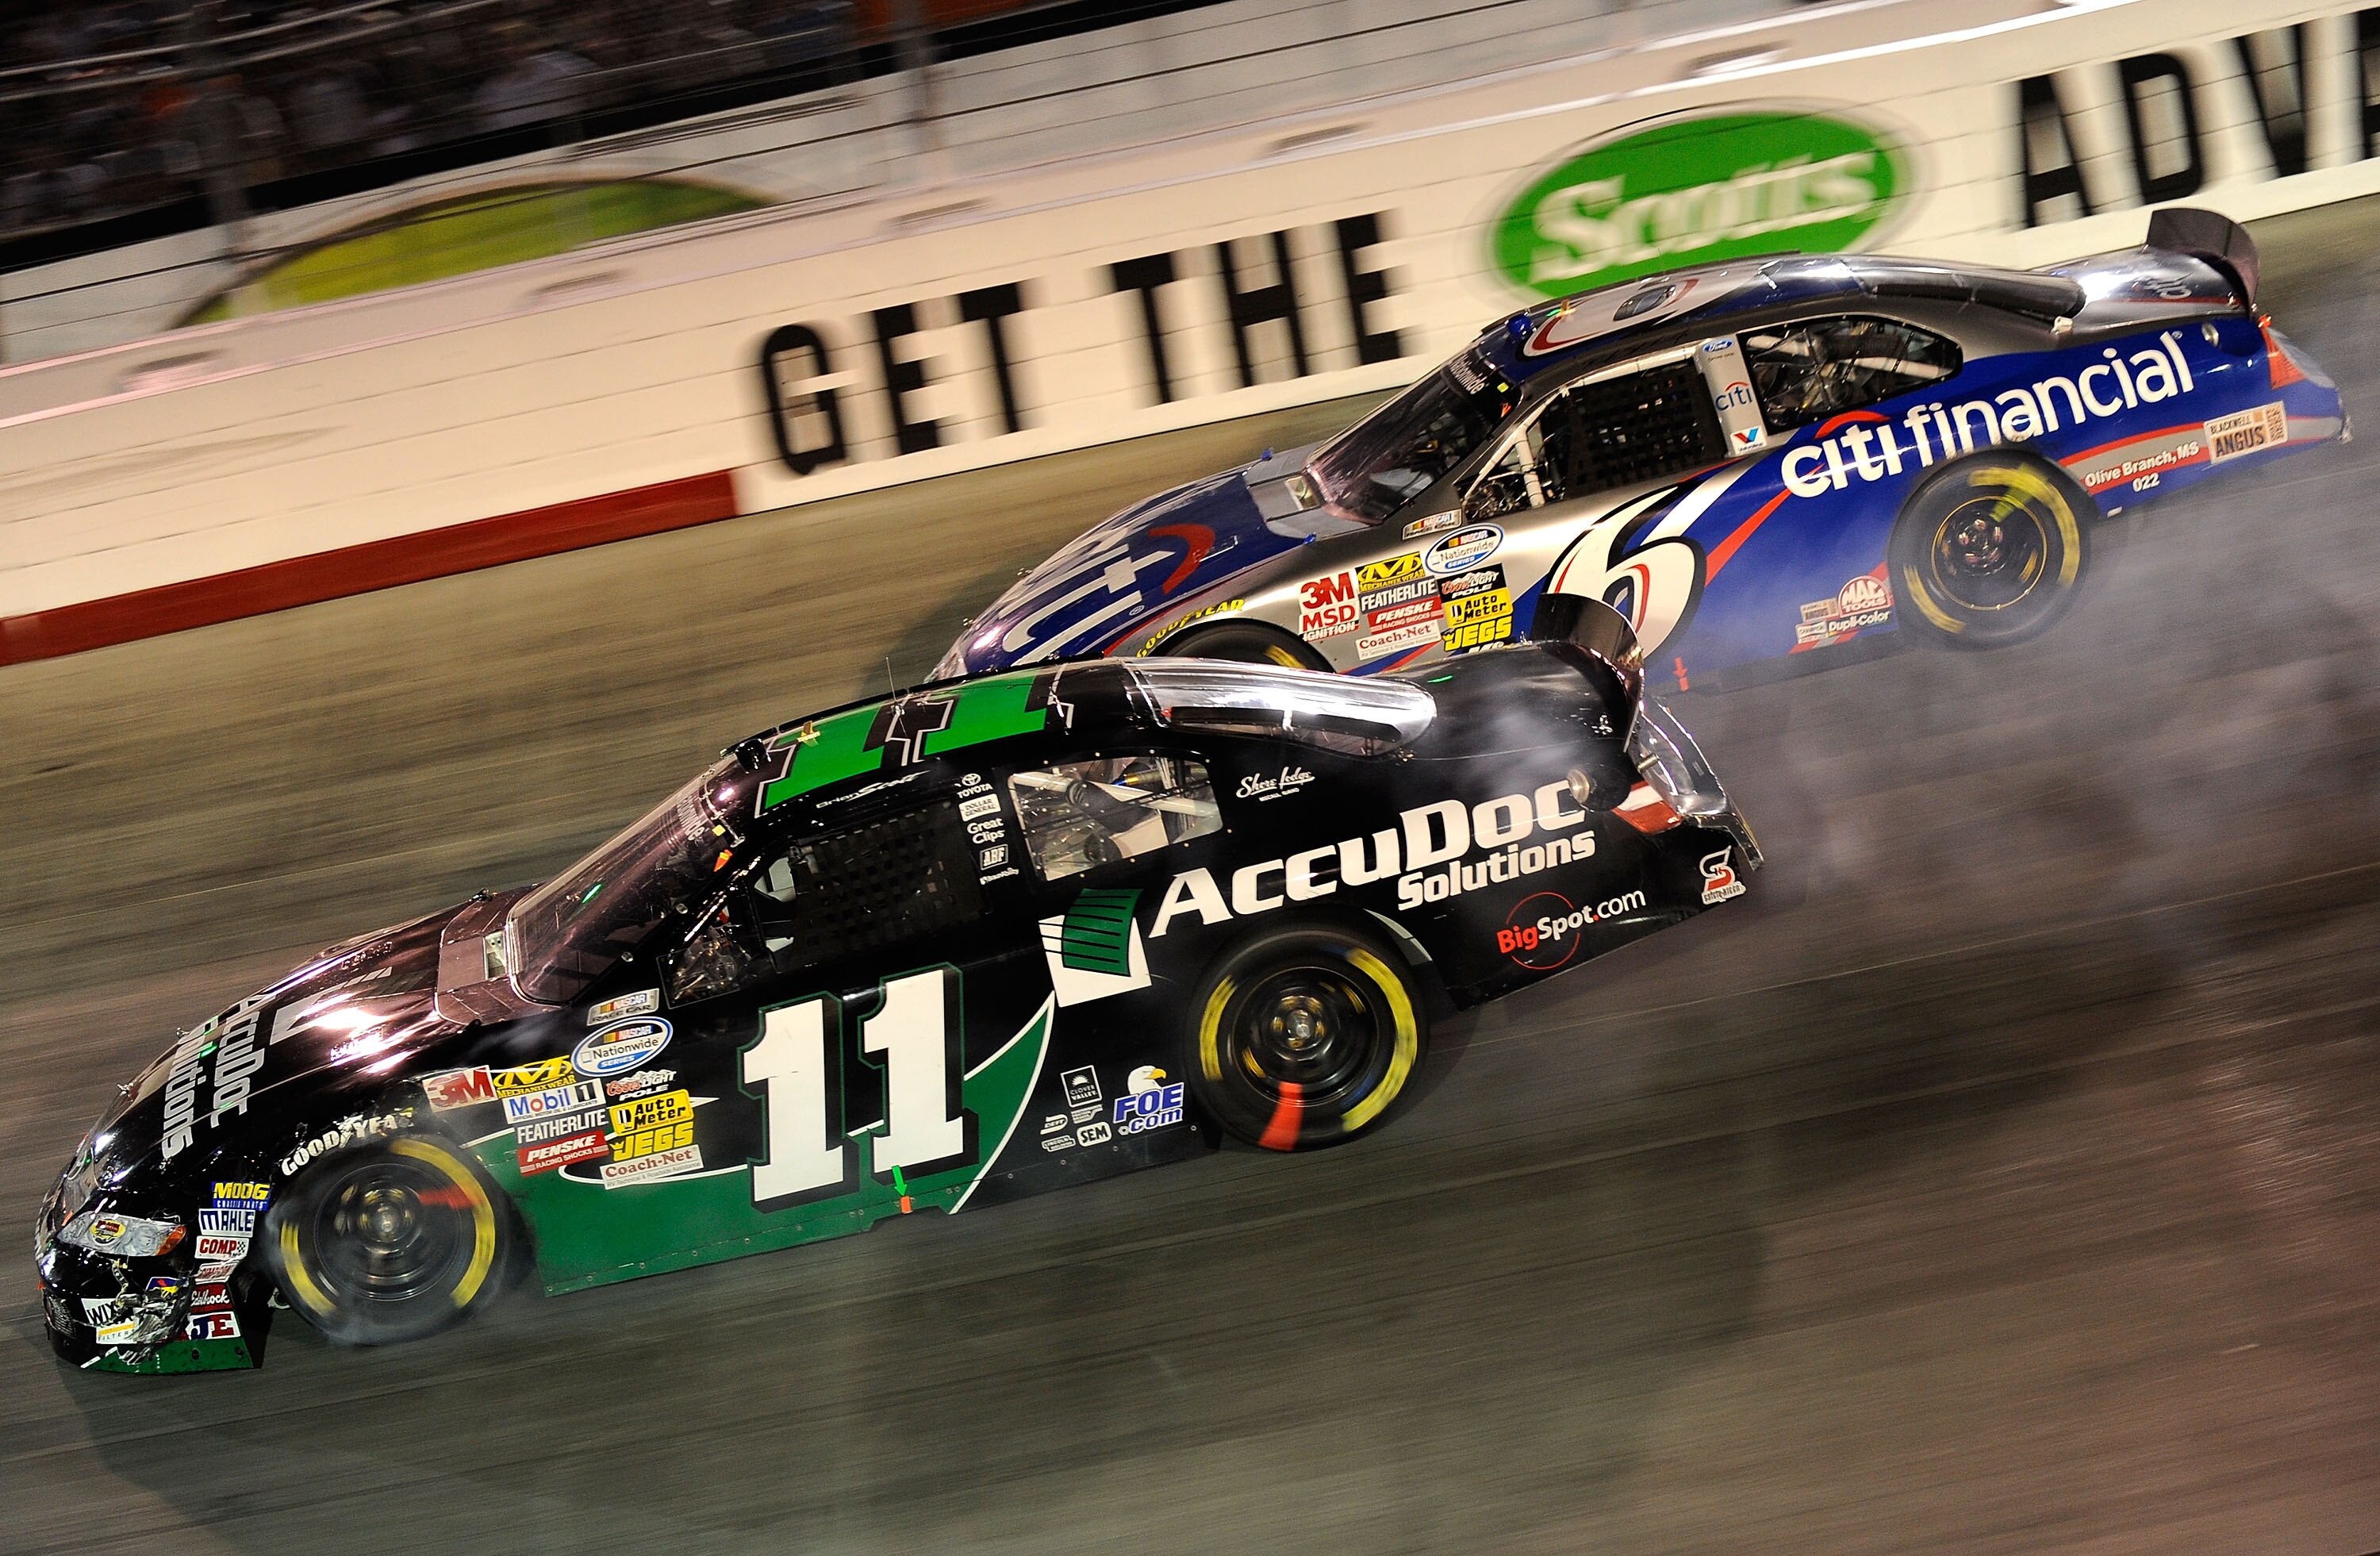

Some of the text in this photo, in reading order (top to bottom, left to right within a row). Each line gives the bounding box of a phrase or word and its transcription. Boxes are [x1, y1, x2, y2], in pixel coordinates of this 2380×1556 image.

[1532, 151, 1877, 284] Scotts
[755, 210, 1406, 477] GET THE
[1715, 386, 1753, 411] citi
[2209, 415, 2251, 434] BLACKWELL
[2214, 426, 2266, 458] ANGUS
[2084, 440, 2200, 487] Olive Branch, MS
[2132, 471, 2160, 493] 022
[1440, 540, 1495, 563] Nationwide
[1547, 484, 1702, 660] 6
[1301, 571, 1355, 609] 3M
[1361, 578, 1438, 612] FEATHERLITE
[1451, 583, 1492, 599] POLE
[1467, 594, 1498, 609] Auto
[1841, 579, 1886, 606] MAC
[1376, 600, 1434, 624] PENSKE
[1464, 601, 1507, 623] Meter
[1843, 596, 1887, 613] TOOLS
[1303, 605, 1356, 632] MSD
[1303, 621, 1356, 642] IGNITION
[1359, 624, 1433, 650] Coach-Net
[1444, 616, 1513, 651] JEGS
[957, 782, 993, 799] TOYOTA
[965, 798, 993, 810] DOLLAR
[965, 804, 997, 817] GENERAL
[967, 817, 1004, 835] Great
[972, 829, 1006, 844] Clips
[1396, 830, 1596, 912] Solutions
[1496, 889, 1647, 955] BigSpot.com
[591, 1004, 651, 1023] RACE CAR
[593, 1038, 659, 1060] Nationwide
[601, 1055, 635, 1068] SERIES
[429, 1067, 494, 1108] 3M
[497, 1074, 577, 1099] MECHANIX WEAR
[607, 1070, 677, 1096] Coors LIGHT
[619, 1084, 670, 1101] POLE
[744, 970, 963, 1202] 11
[1069, 1085, 1096, 1095] CLOVER
[509, 1084, 591, 1117] Mobil 1
[635, 1097, 674, 1116] Auto
[1114, 1082, 1184, 1124] FOE
[516, 1109, 609, 1144] FEATHERLITE
[634, 1107, 686, 1129] Meter
[613, 1121, 694, 1162] JEGS
[1081, 1125, 1108, 1143] SEM
[527, 1134, 597, 1162] PENSKE
[535, 1147, 593, 1170] RACING SHOCKS
[605, 1149, 693, 1178] Coach-Net
[213, 1182, 271, 1200] MOOG
[201, 1210, 254, 1233] MAHLE
[199, 1239, 237, 1254] COMP
[191, 1290, 230, 1306] Edelbrock
[86, 1298, 119, 1325] WIX
[190, 1313, 235, 1340] JE
